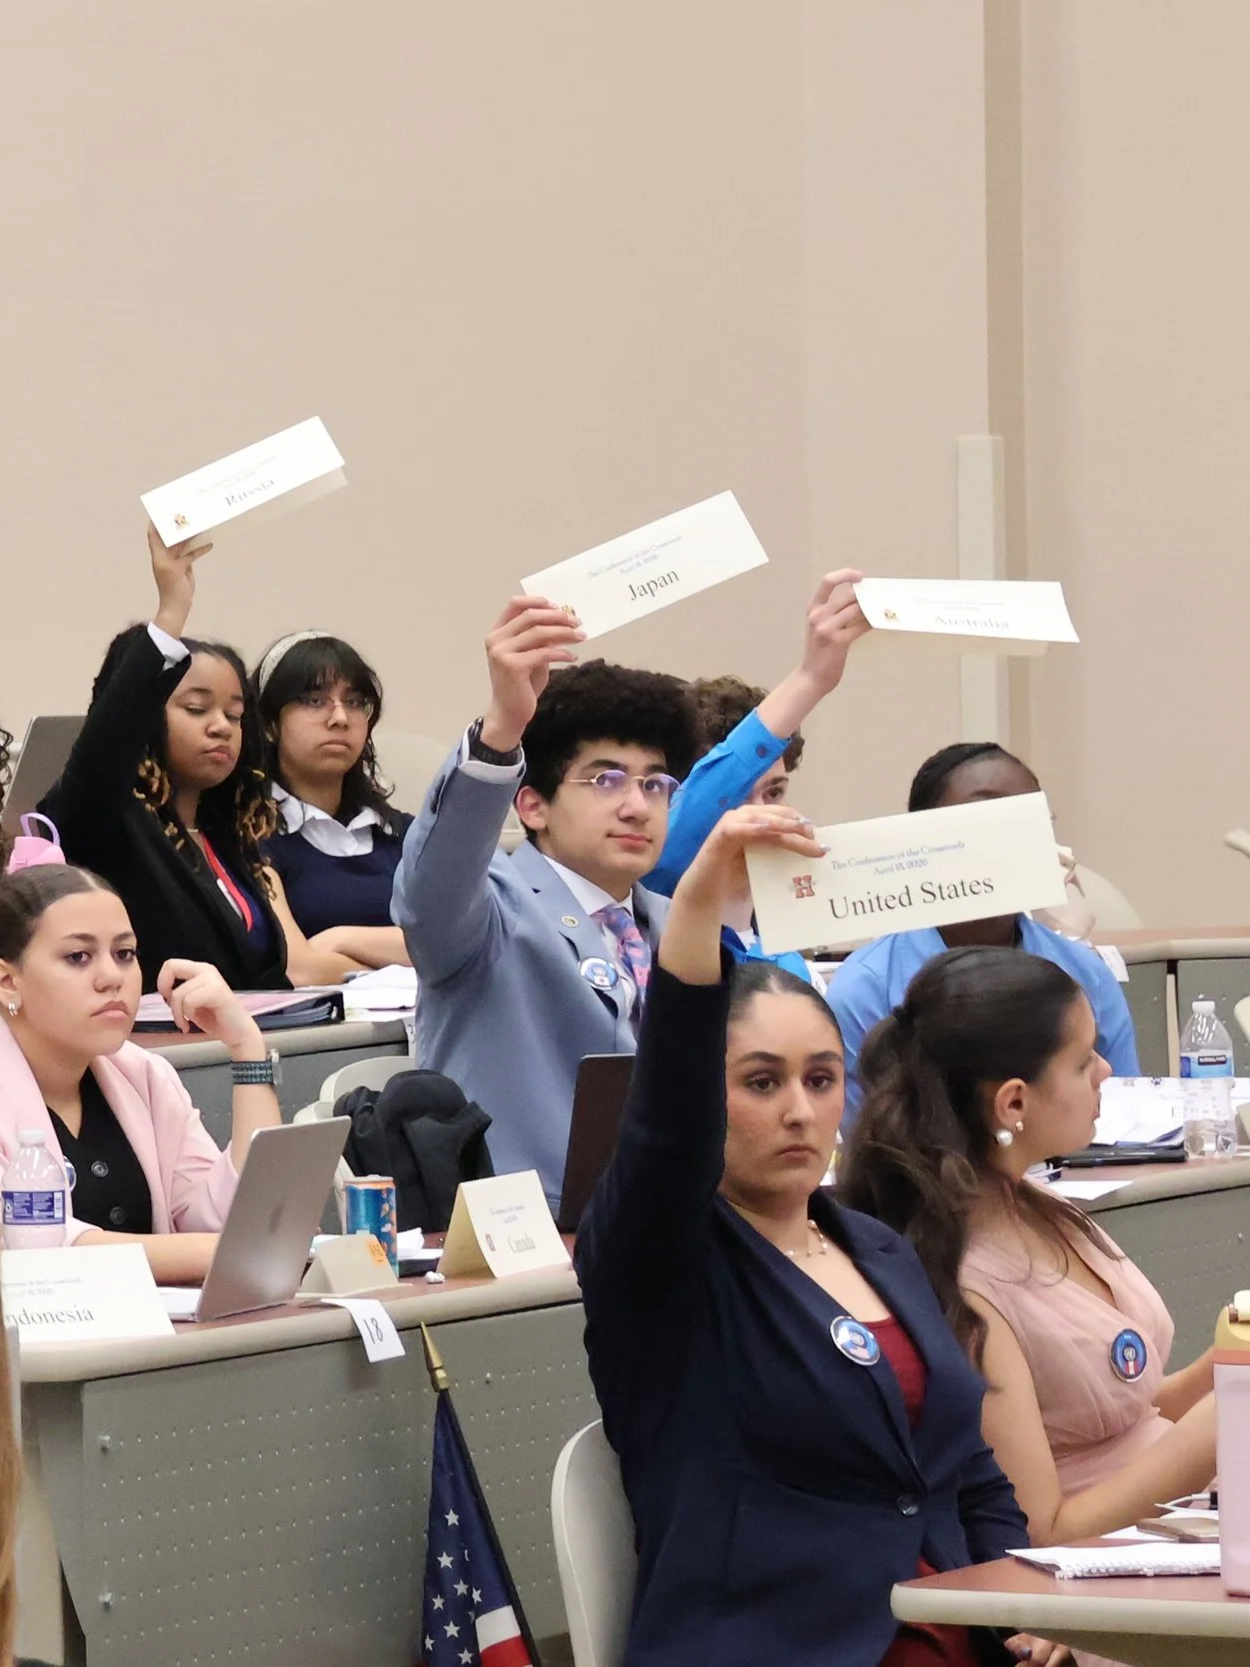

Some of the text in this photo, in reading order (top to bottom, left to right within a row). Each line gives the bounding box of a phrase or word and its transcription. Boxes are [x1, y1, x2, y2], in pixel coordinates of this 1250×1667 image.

[628, 569, 680, 601] Japan
[935, 615, 1010, 630] Australia
[829, 877, 995, 920] United States
[5, 1304, 95, 1326] ndonesia
[363, 1317, 384, 1345] 18
